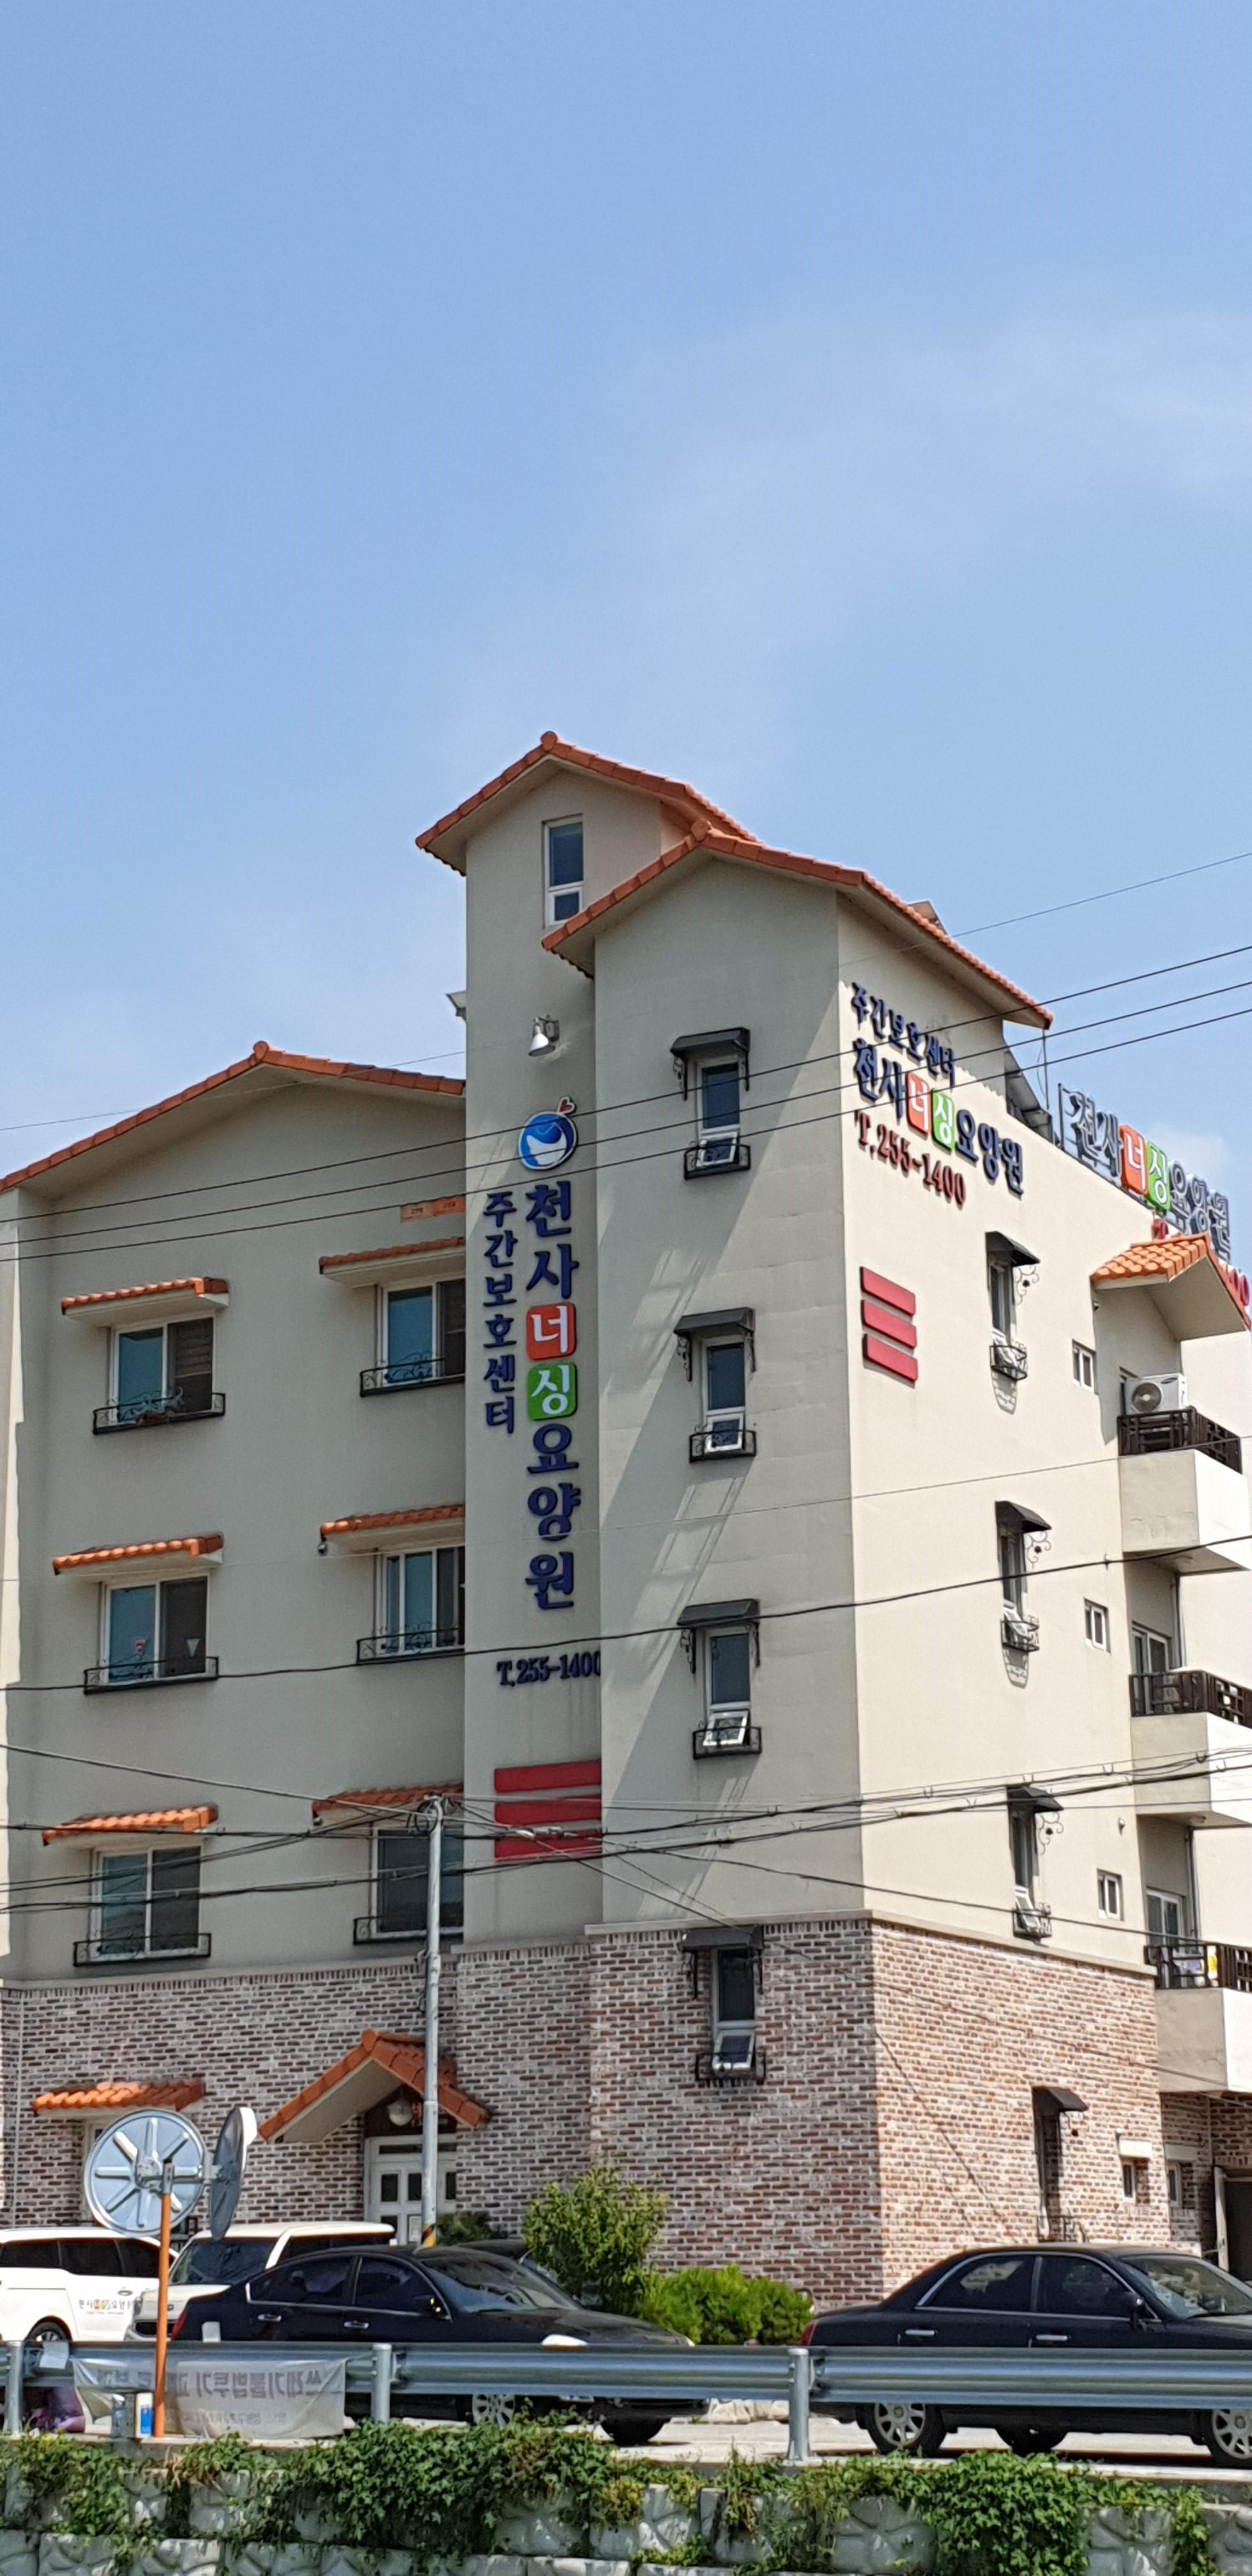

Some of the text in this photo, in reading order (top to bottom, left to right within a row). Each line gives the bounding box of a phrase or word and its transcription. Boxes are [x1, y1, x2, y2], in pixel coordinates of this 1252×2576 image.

[851, 982, 956, 1089] 주간보호센터
[853, 1037, 1024, 1197] 천사너싱요양원
[855, 1108, 966, 1208] T.255-1400
[1069, 1089, 1231, 1261] 천사너싱요양원
[483, 1191, 517, 1434] 주간보호센터
[524, 1180, 581, 1610] 천사너싱요양원
